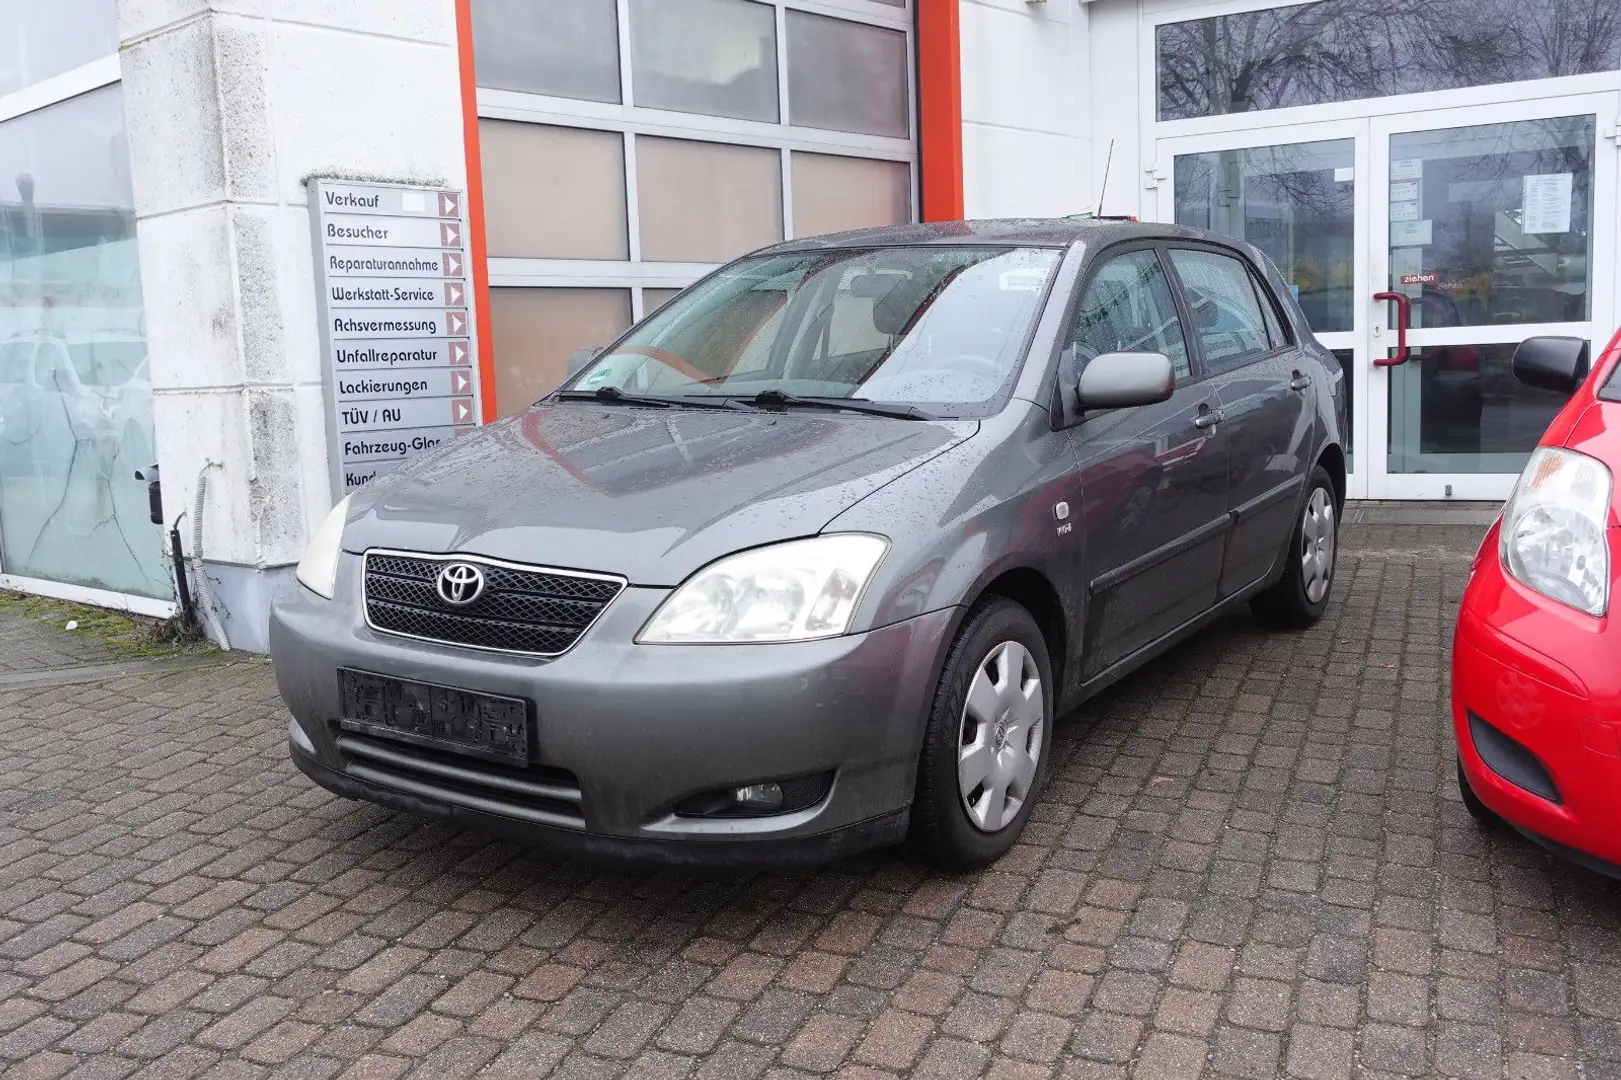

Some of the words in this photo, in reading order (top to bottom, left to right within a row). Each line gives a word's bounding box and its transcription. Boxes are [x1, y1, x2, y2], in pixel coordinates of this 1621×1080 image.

[325, 190, 379, 208] Verkauf
[327, 223, 389, 240] Besucher
[329, 255, 439, 274] Reparaturannahme
[1404, 274, 1434, 283] ziehen
[331, 286, 435, 301] Werkstatt-Service
[334, 317, 437, 335] Achsvermessung
[336, 348, 438, 366] Unfallreparatur
[339, 379, 428, 396] Lackierungen
[341, 408, 369, 425] TÜV
[372, 410, 378, 424] /
[382, 408, 401, 423] AU
